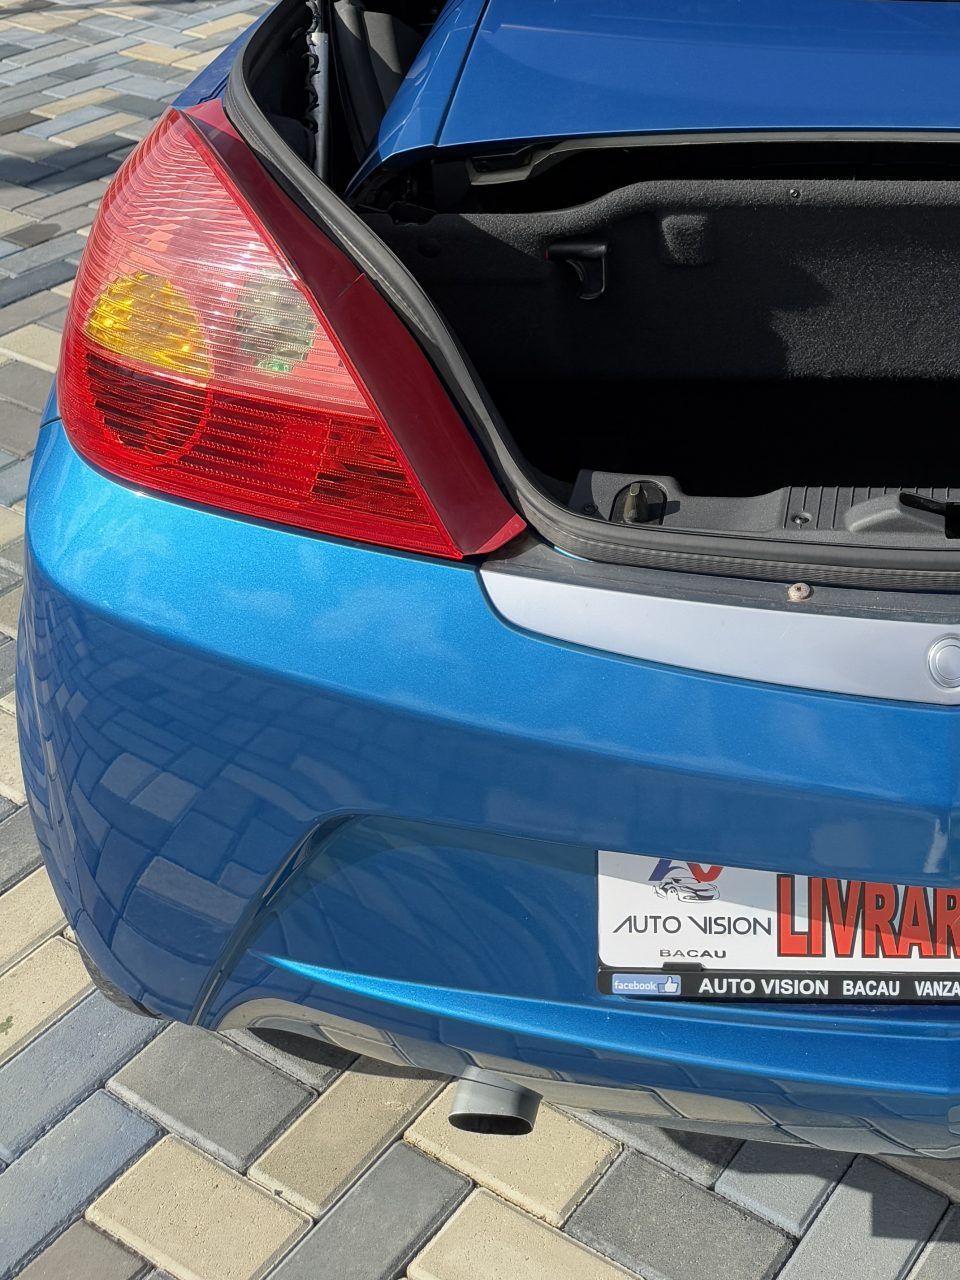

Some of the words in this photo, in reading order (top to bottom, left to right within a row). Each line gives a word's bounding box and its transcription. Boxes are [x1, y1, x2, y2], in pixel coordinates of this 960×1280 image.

[613, 915, 682, 934] AUTO
[688, 915, 772, 936] VISION
[659, 949, 727, 959] BACAU
[615, 980, 657, 991] facebook
[699, 978, 756, 995] AUTO
[761, 979, 829, 996] VISION
[842, 980, 900, 996] BACAU
